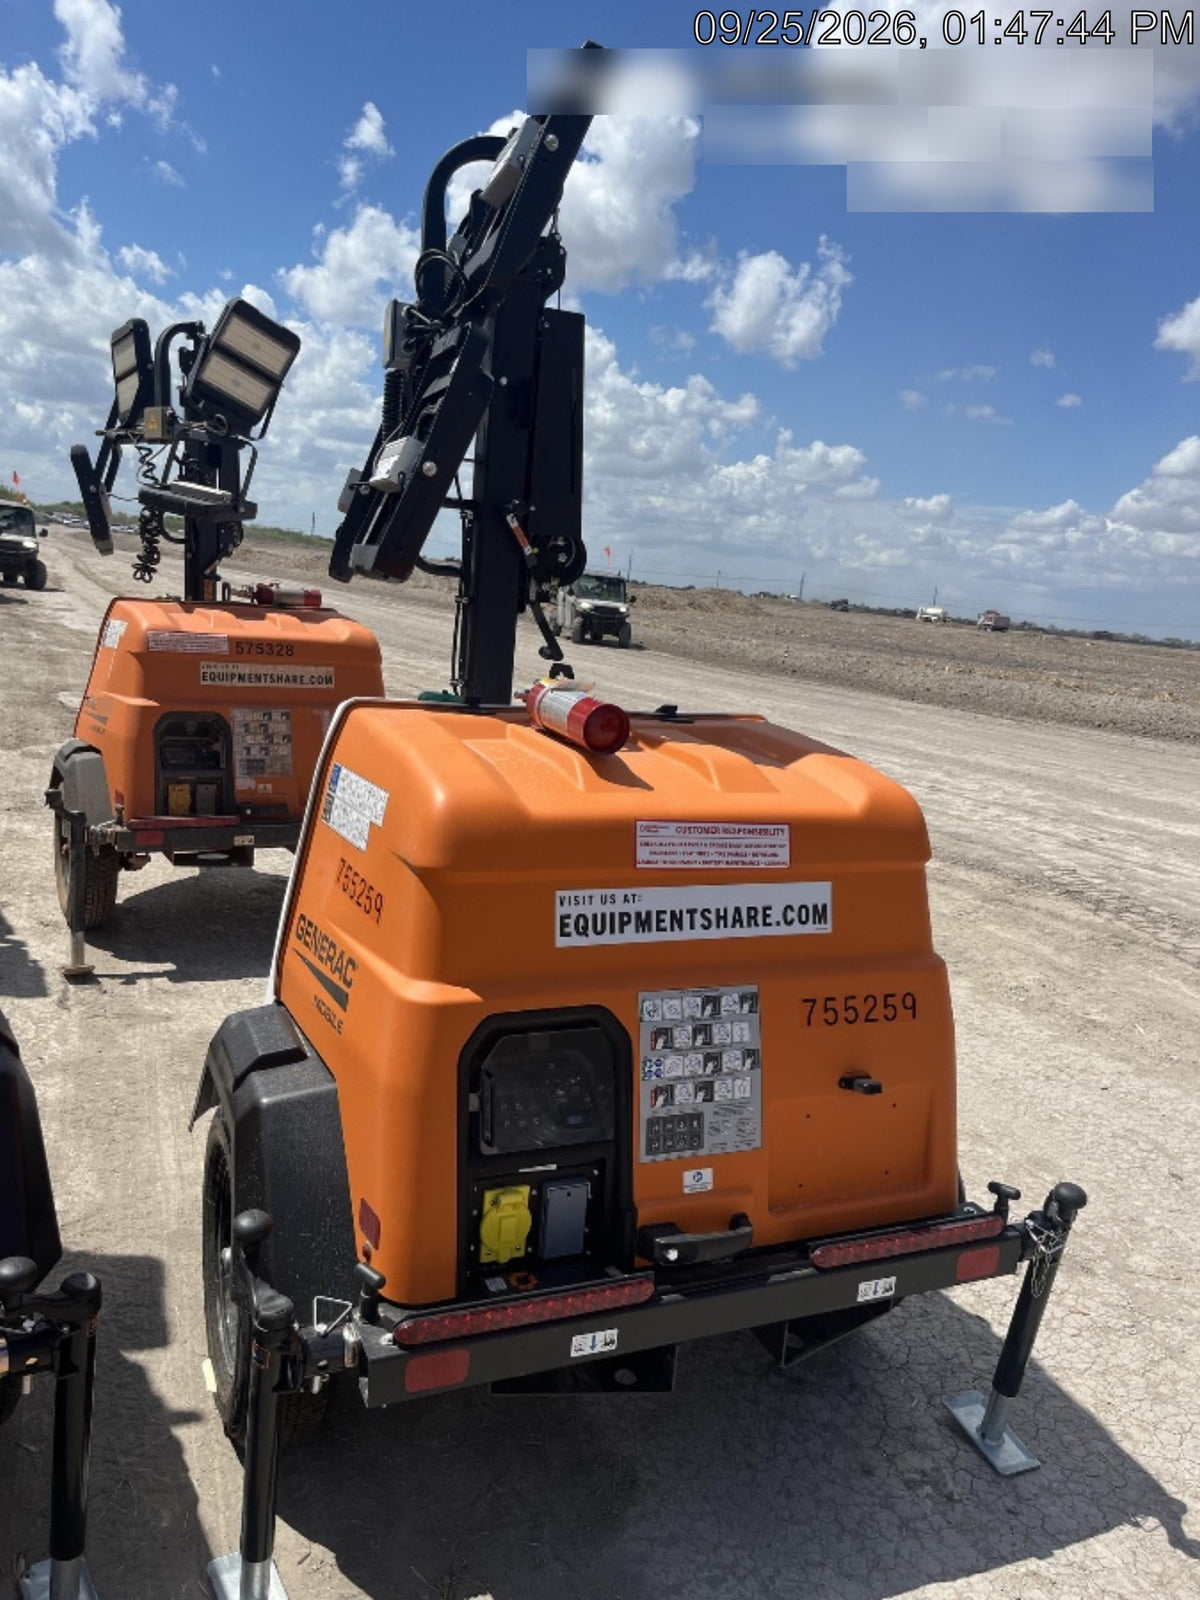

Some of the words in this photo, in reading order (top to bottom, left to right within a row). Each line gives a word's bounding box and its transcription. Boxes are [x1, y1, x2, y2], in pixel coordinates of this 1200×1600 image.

[235, 641, 294, 656] 575328
[202, 671, 333, 686] EQUIPMENTSHARE.COM
[336, 857, 384, 925] 755259
[559, 895, 594, 907] VISIT
[600, 894, 616, 905] US
[623, 893, 642, 904] AT:
[559, 902, 828, 938] EQUIPMENTSHARE.COM
[295, 913, 355, 988] GENERAC
[802, 993, 917, 1026] 755259
